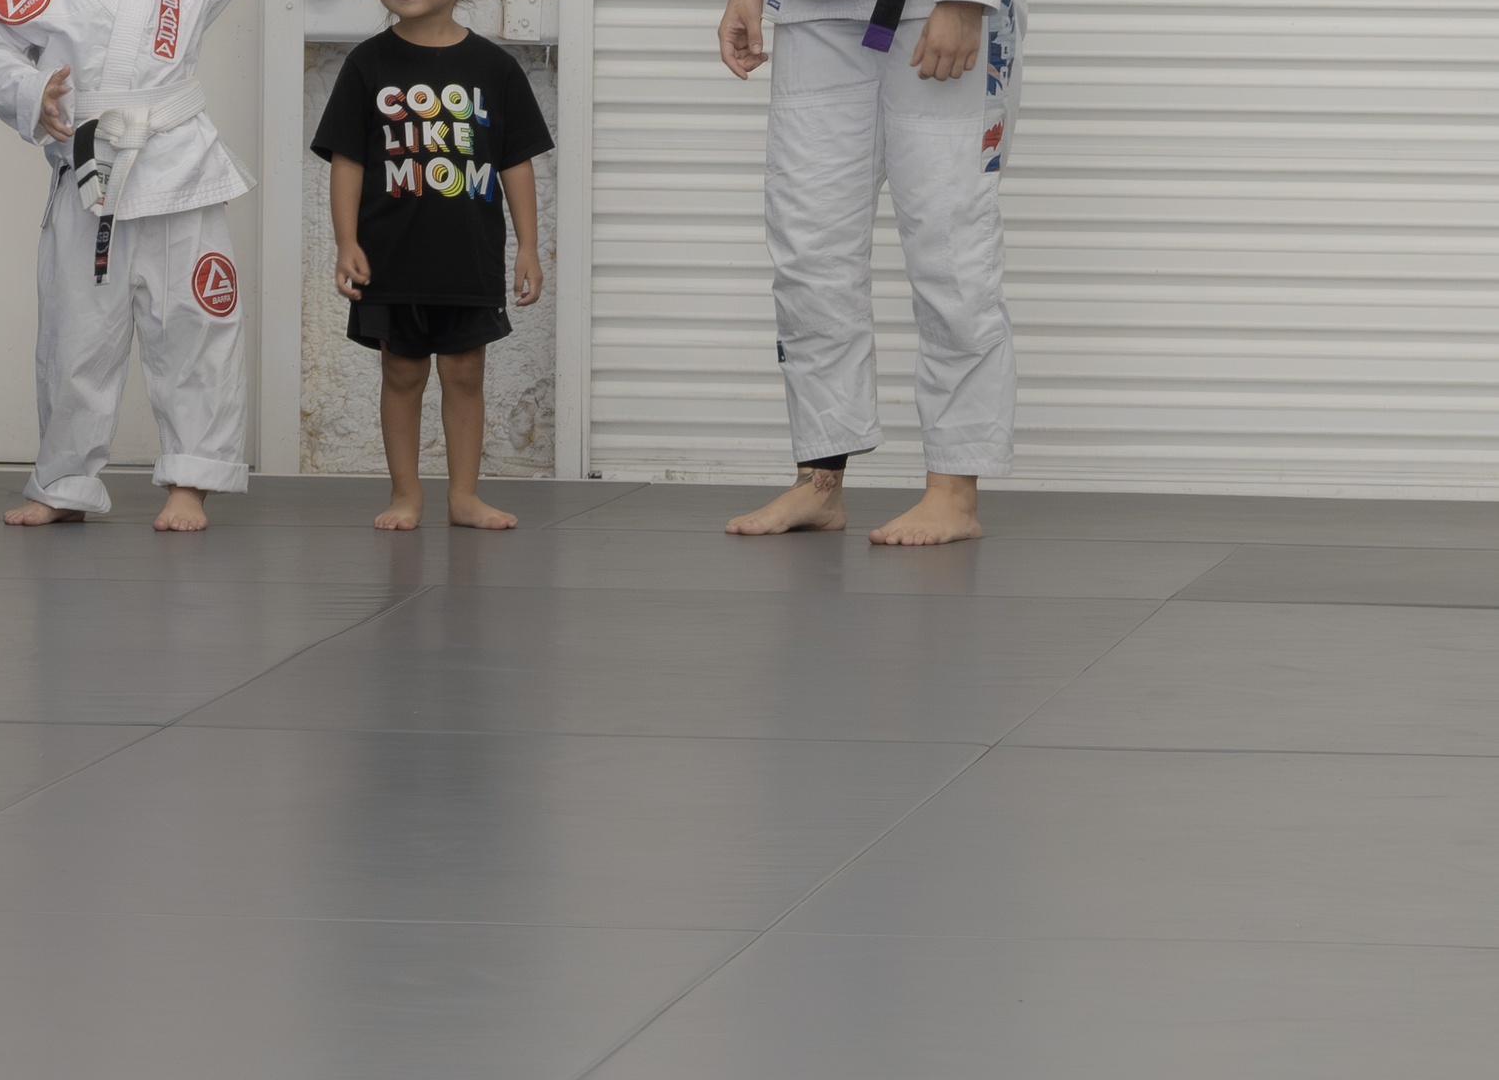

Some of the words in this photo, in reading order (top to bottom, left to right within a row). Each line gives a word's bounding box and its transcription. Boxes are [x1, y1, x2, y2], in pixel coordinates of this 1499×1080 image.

[376, 83, 490, 126] COOL
[382, 120, 475, 155] LIKE
[384, 156, 496, 202] MOM
